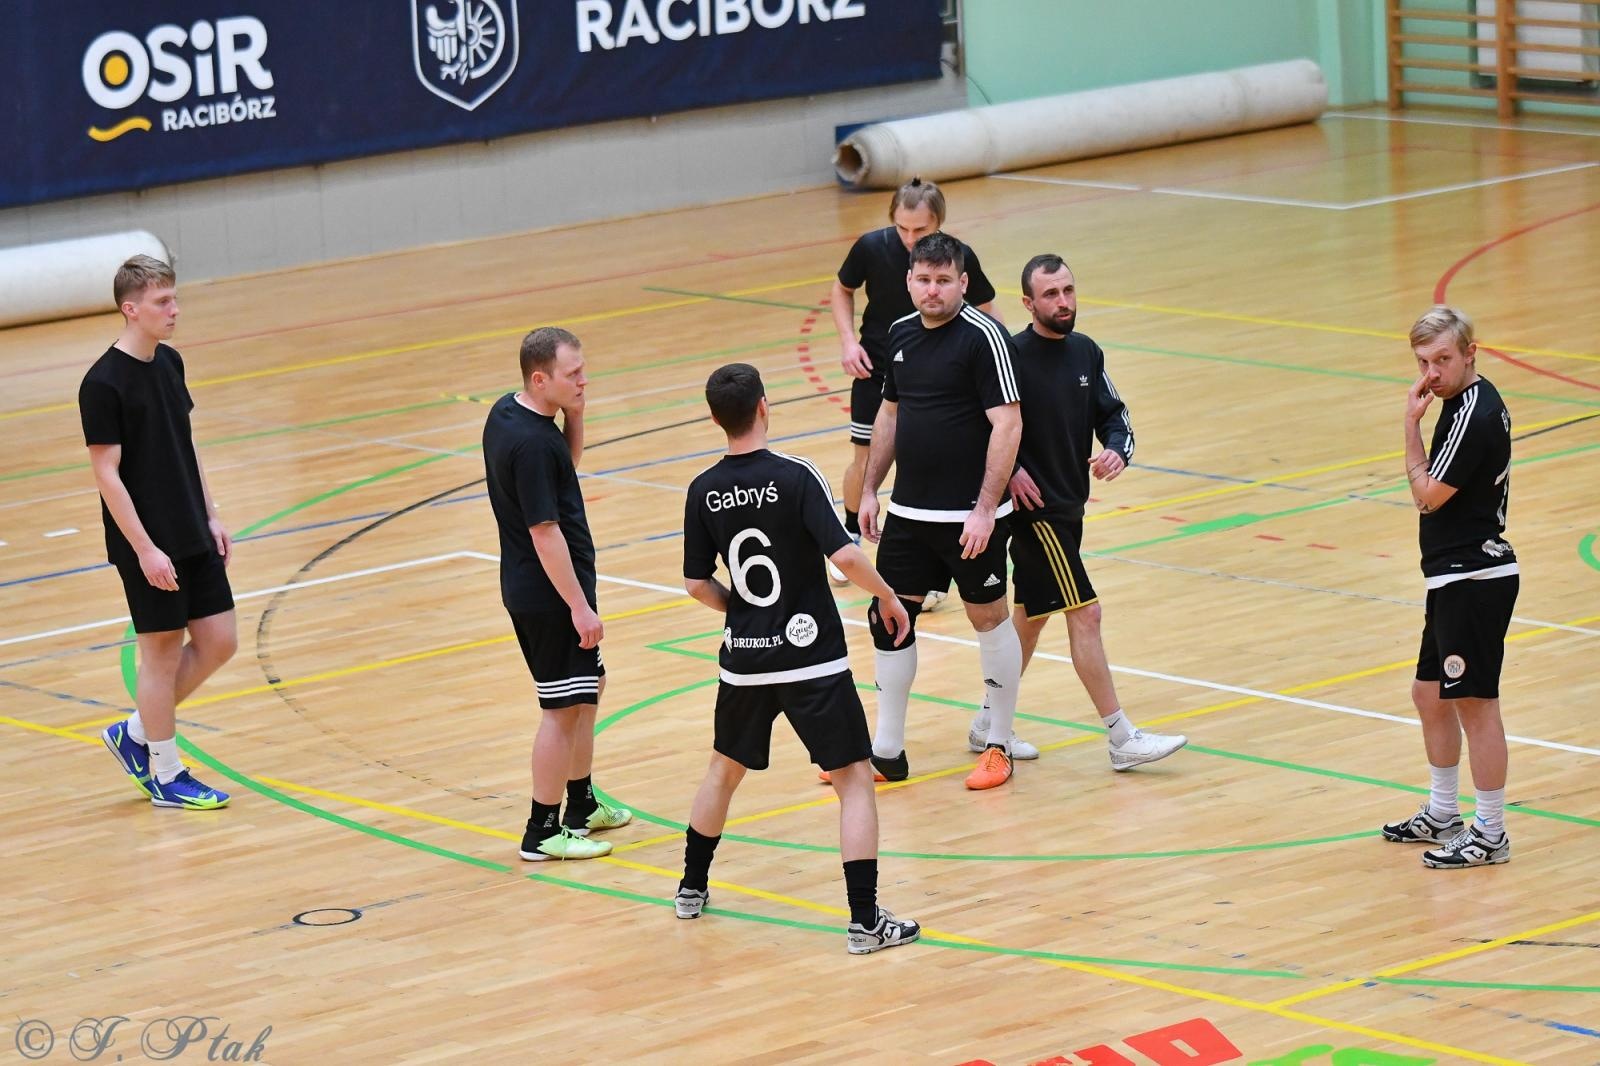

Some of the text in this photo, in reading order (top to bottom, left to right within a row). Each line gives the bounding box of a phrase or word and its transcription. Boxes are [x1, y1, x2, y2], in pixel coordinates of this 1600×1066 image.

[82, 16, 274, 109] OSiR
[162, 95, 276, 132] RACIBÓRZ
[706, 481, 779, 513] Gabryś
[728, 527, 782, 608] 6
[732, 634, 784, 649] DRUKOL.PL
